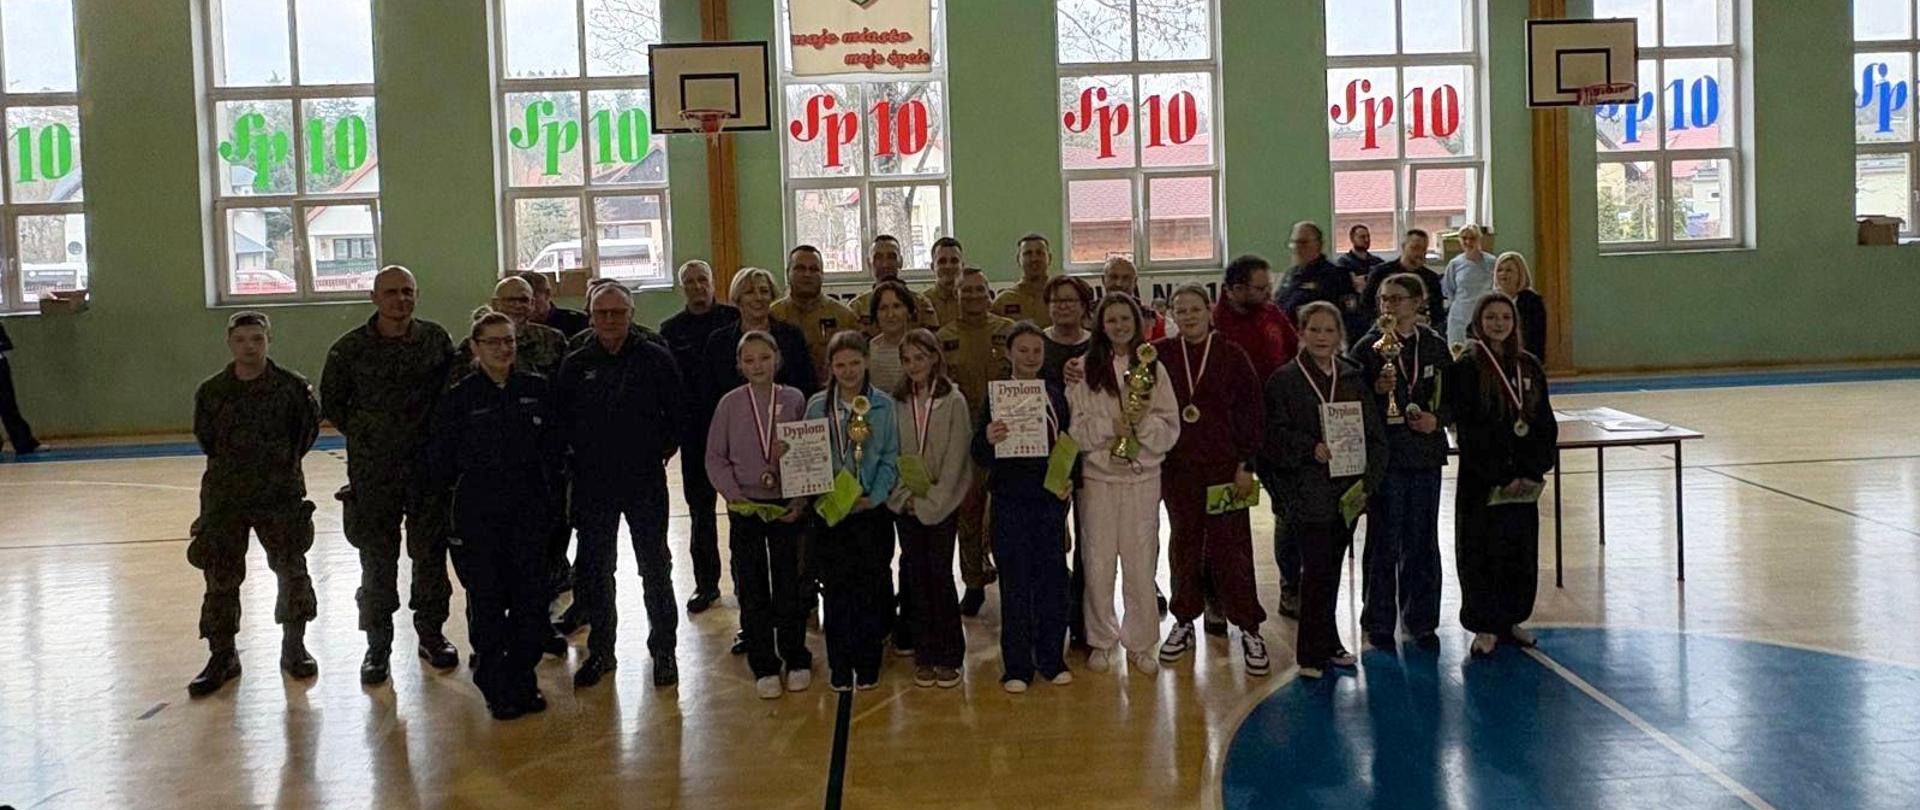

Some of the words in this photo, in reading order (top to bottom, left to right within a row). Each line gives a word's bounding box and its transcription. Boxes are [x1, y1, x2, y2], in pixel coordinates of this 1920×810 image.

[841, 27, 913, 44] miasto
[844, 48, 885, 69] moje
[869, 100, 928, 156] 10
[1140, 91, 1197, 148] 10
[1404, 84, 1459, 139] 10
[1664, 75, 1720, 130] 10
[9, 122, 72, 184] 10
[308, 115, 368, 171] 10
[588, 107, 650, 164] 10
[997, 382, 1042, 398] Dyplom
[783, 422, 826, 440] Dyplom
